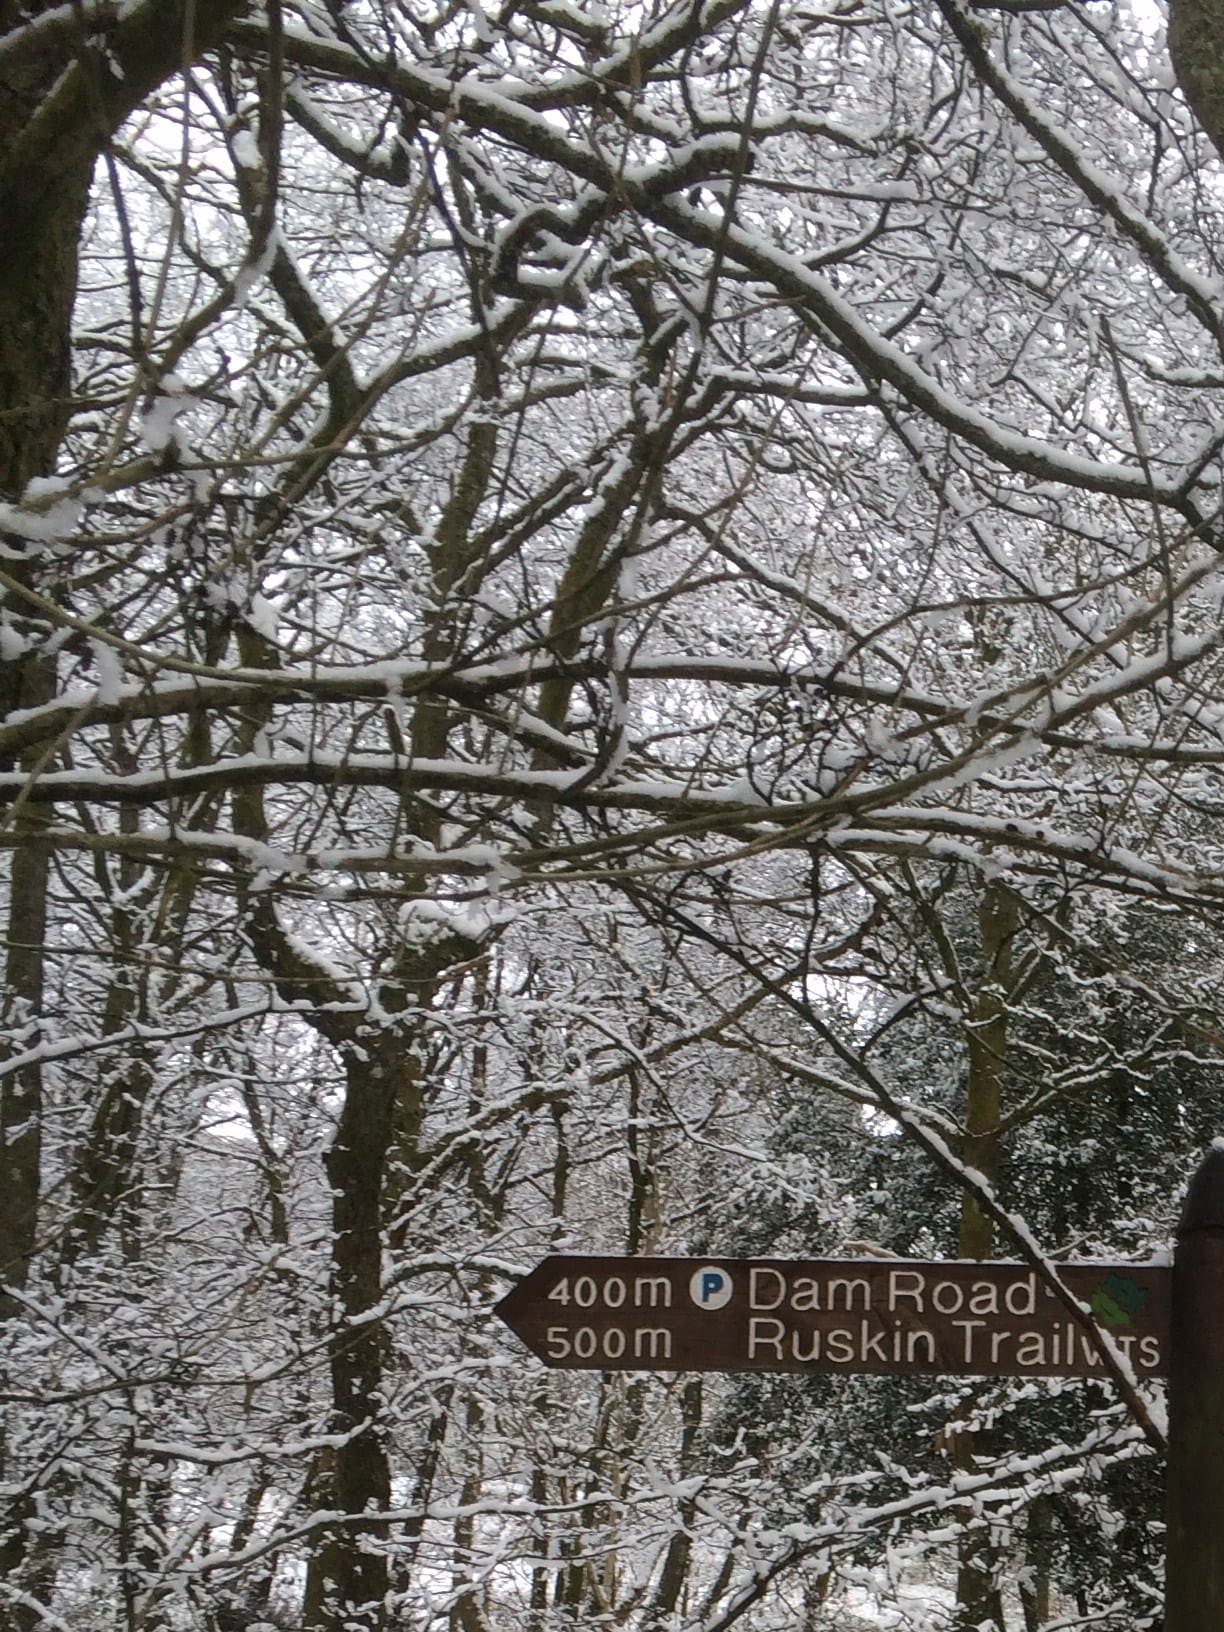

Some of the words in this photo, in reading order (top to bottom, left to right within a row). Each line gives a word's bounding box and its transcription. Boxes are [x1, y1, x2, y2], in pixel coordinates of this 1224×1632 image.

[547, 1276, 672, 1308] 400m
[702, 1272, 724, 1303] P
[748, 1268, 871, 1312] Dam
[888, 1271, 1037, 1315] Road
[546, 1327, 672, 1359] 500m
[747, 1317, 936, 1364] Ruskin
[951, 1320, 1074, 1367] Trail
